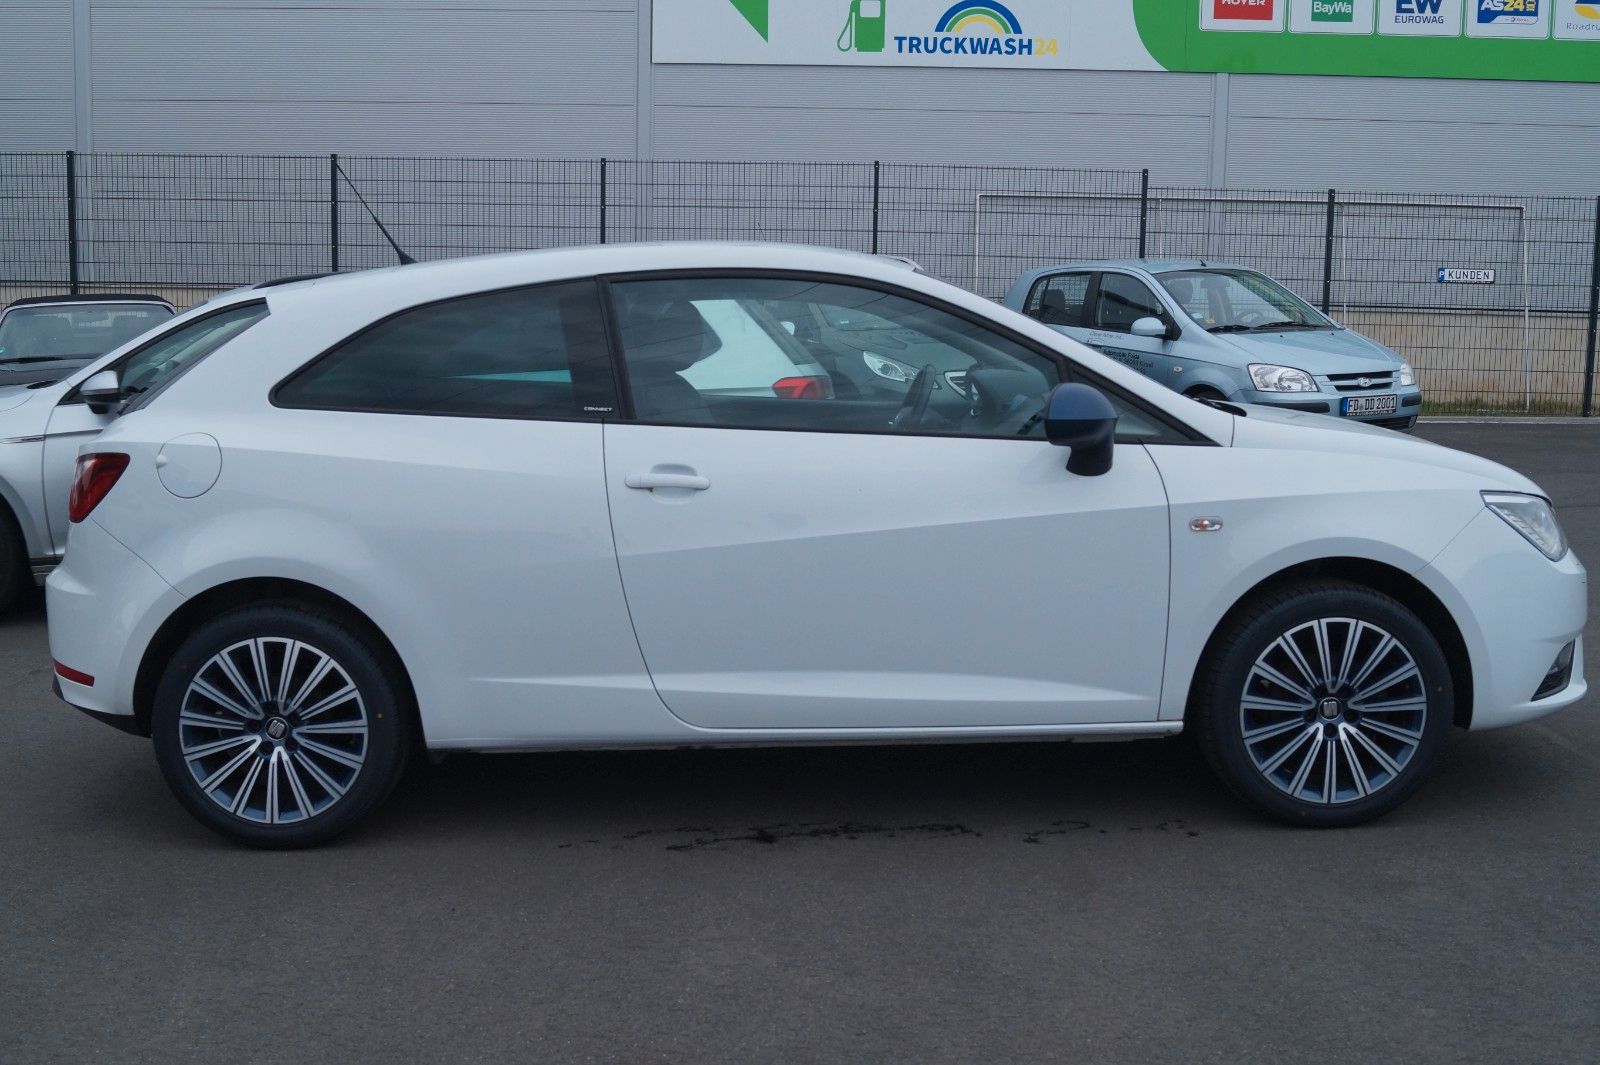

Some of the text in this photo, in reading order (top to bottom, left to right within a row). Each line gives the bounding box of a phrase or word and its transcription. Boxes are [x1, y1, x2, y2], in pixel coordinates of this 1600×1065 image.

[1313, 2, 1352, 15] BayWa
[1394, 16, 1444, 24] EUROWAG
[894, 36, 1059, 56] TRUCKWASH24
[1448, 270, 1490, 280] KUNDEN
[1348, 396, 1395, 411] FD DD 2001
